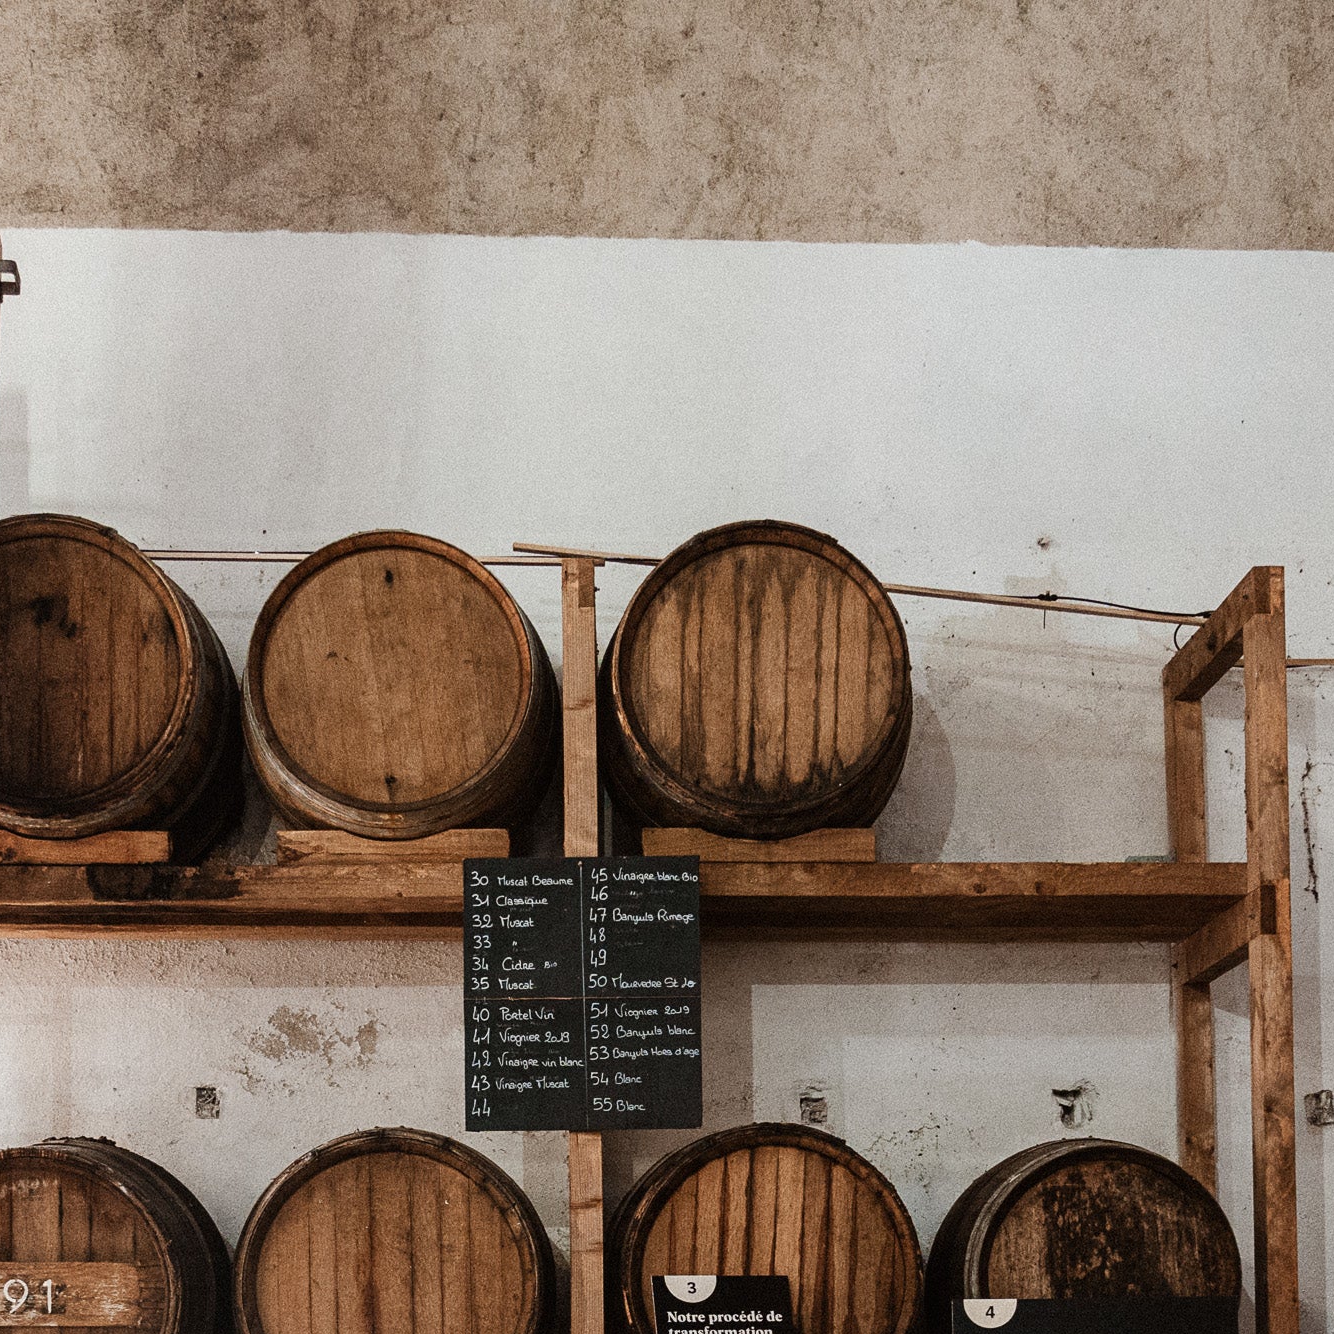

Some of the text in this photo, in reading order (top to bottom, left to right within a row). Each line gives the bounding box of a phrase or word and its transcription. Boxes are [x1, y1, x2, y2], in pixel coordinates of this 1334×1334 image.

[470, 872, 574, 886] 30 Muscat Beaume
[591, 867, 698, 883] 45 Vinaigre blanc Bio
[591, 886, 608, 900] 46
[472, 896, 548, 907] 31 Classique
[472, 914, 534, 928] 32 Muscat
[589, 907, 607, 922] 47
[613, 908, 654, 922] Banyuls
[589, 928, 606, 943] 48
[473, 937, 492, 949] 33
[472, 958, 489, 971] 34
[502, 957, 535, 971] Cidre
[590, 950, 607, 966] 49
[471, 976, 534, 990] 35 Muscat
[589, 975, 607, 988] 50
[664, 977, 679, 988] St
[472, 1009, 490, 1022] 40
[535, 1010, 554, 1020] Vin
[590, 1002, 690, 1019] 51 Viognier 2019
[590, 1024, 695, 1039] 52 Banyuls blanc
[473, 1031, 570, 1047] 41 Viognier 2019
[589, 1047, 610, 1060] 53
[613, 1047, 649, 1059] Banyuls
[472, 1052, 584, 1070] 42 Vinaigre vin blanc
[471, 1076, 570, 1092] 43 Vinaigre Muscat
[590, 1072, 642, 1086] 54 Blanc
[471, 1098, 491, 1117] 44
[593, 1098, 646, 1111] 55 Blanc
[687, 1282, 697, 1294] 3
[3, 1279, 53, 1314] 91
[667, 1310, 783, 1325] Notre procédé de
[985, 1305, 996, 1319] 4
